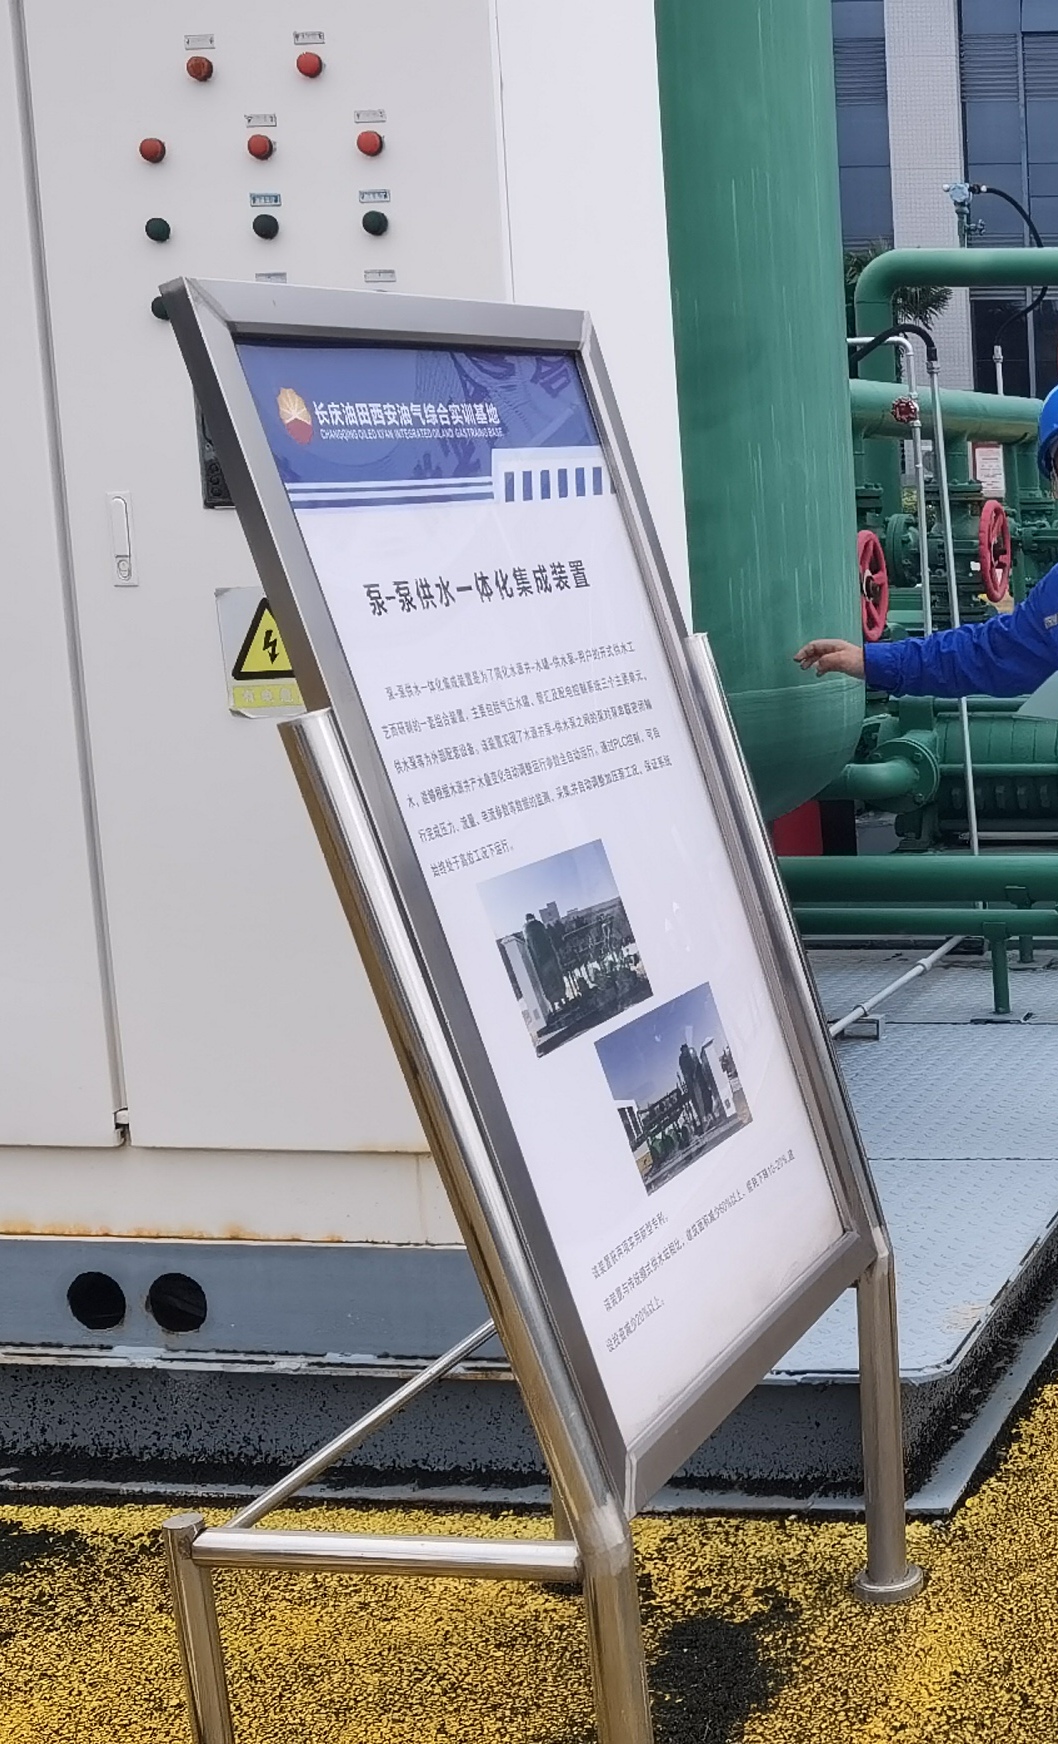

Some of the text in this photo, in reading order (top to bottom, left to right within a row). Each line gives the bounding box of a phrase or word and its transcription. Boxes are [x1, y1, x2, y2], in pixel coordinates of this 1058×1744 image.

[313, 401, 500, 426] 长庆油田西安油气综合实训基地
[363, 560, 590, 616] 泵-泵供水一体化集成装置
